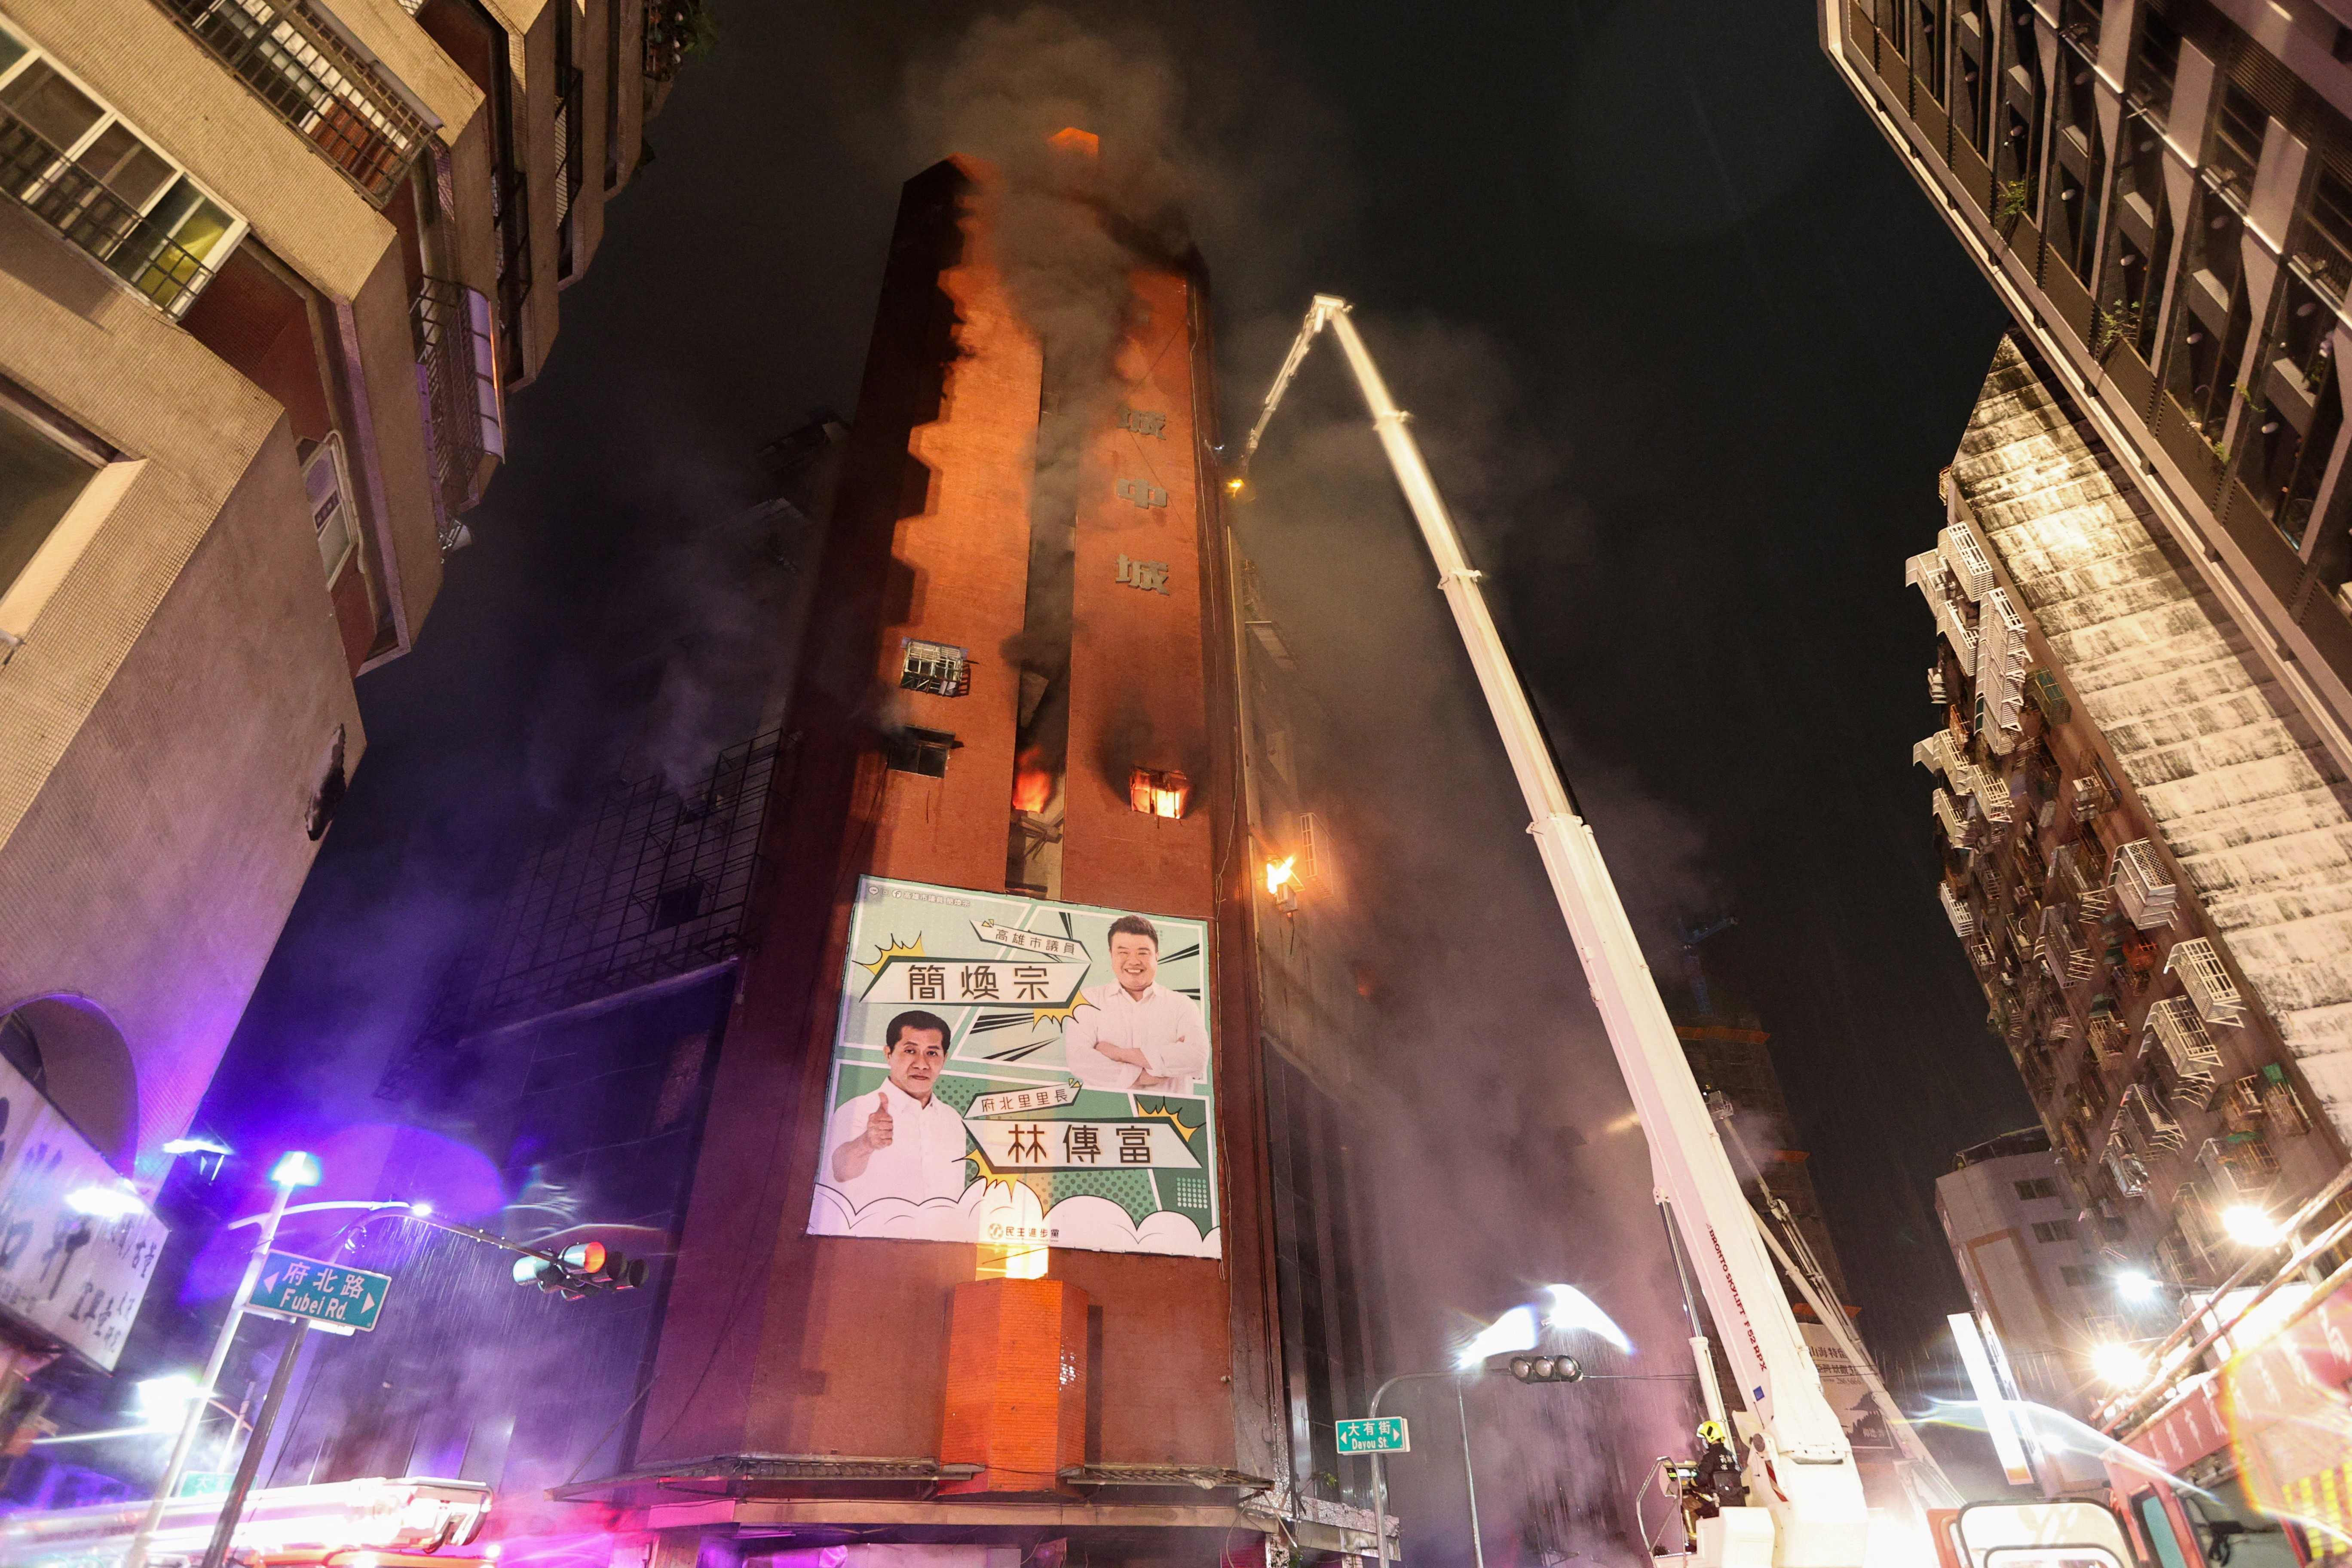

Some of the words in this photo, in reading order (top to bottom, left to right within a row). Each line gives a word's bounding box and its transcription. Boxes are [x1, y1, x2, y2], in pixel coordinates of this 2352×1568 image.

[904, 891, 943, 904] 高雄市議員
[995, 929, 1074, 955] 高雄市議員
[907, 965, 1049, 1000] 簡煥宗
[981, 1089, 1067, 1112] 府北里里長
[1008, 1124, 1151, 1164] 林傳富
[282, 1262, 365, 1299] 府北路
[280, 1288, 325, 1314] Fubei
[325, 1298, 348, 1320] Rd.
[1709, 1229, 1728, 1272] BRONTO
[1726, 1273, 1746, 1315] SKYLIFT
[1747, 1329, 1756, 1344] 52
[1754, 1345, 1767, 1372] RPX
[1348, 1421, 1390, 1436] 大有街
[1352, 1438, 1376, 1451] Dayou
[1378, 1437, 1389, 1448] St.
